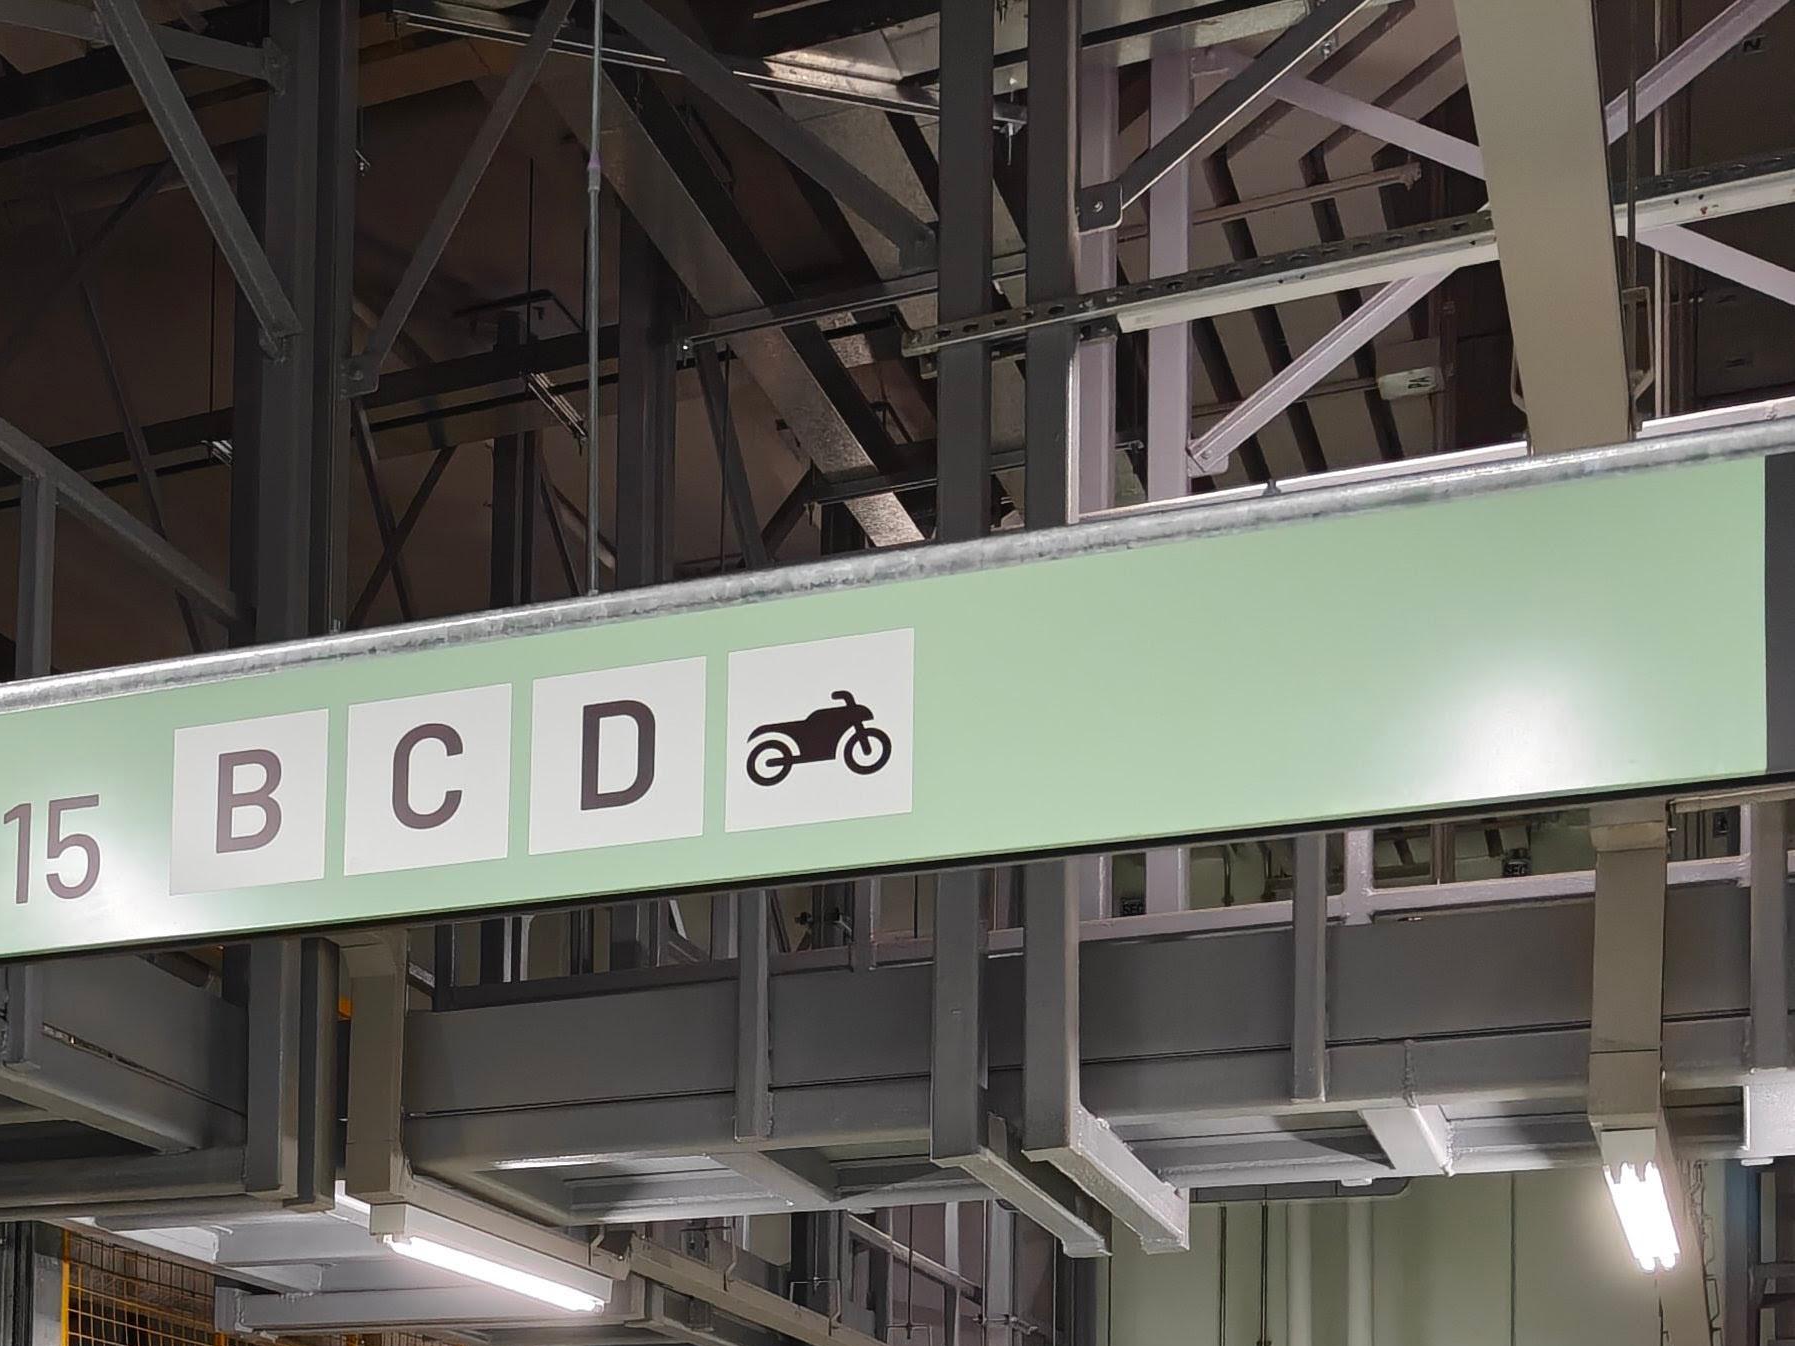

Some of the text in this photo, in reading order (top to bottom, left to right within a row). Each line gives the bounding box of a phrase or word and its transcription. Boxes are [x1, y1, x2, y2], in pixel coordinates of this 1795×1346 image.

[215, 748, 284, 854] B
[390, 722, 464, 831] C
[580, 698, 657, 812] D
